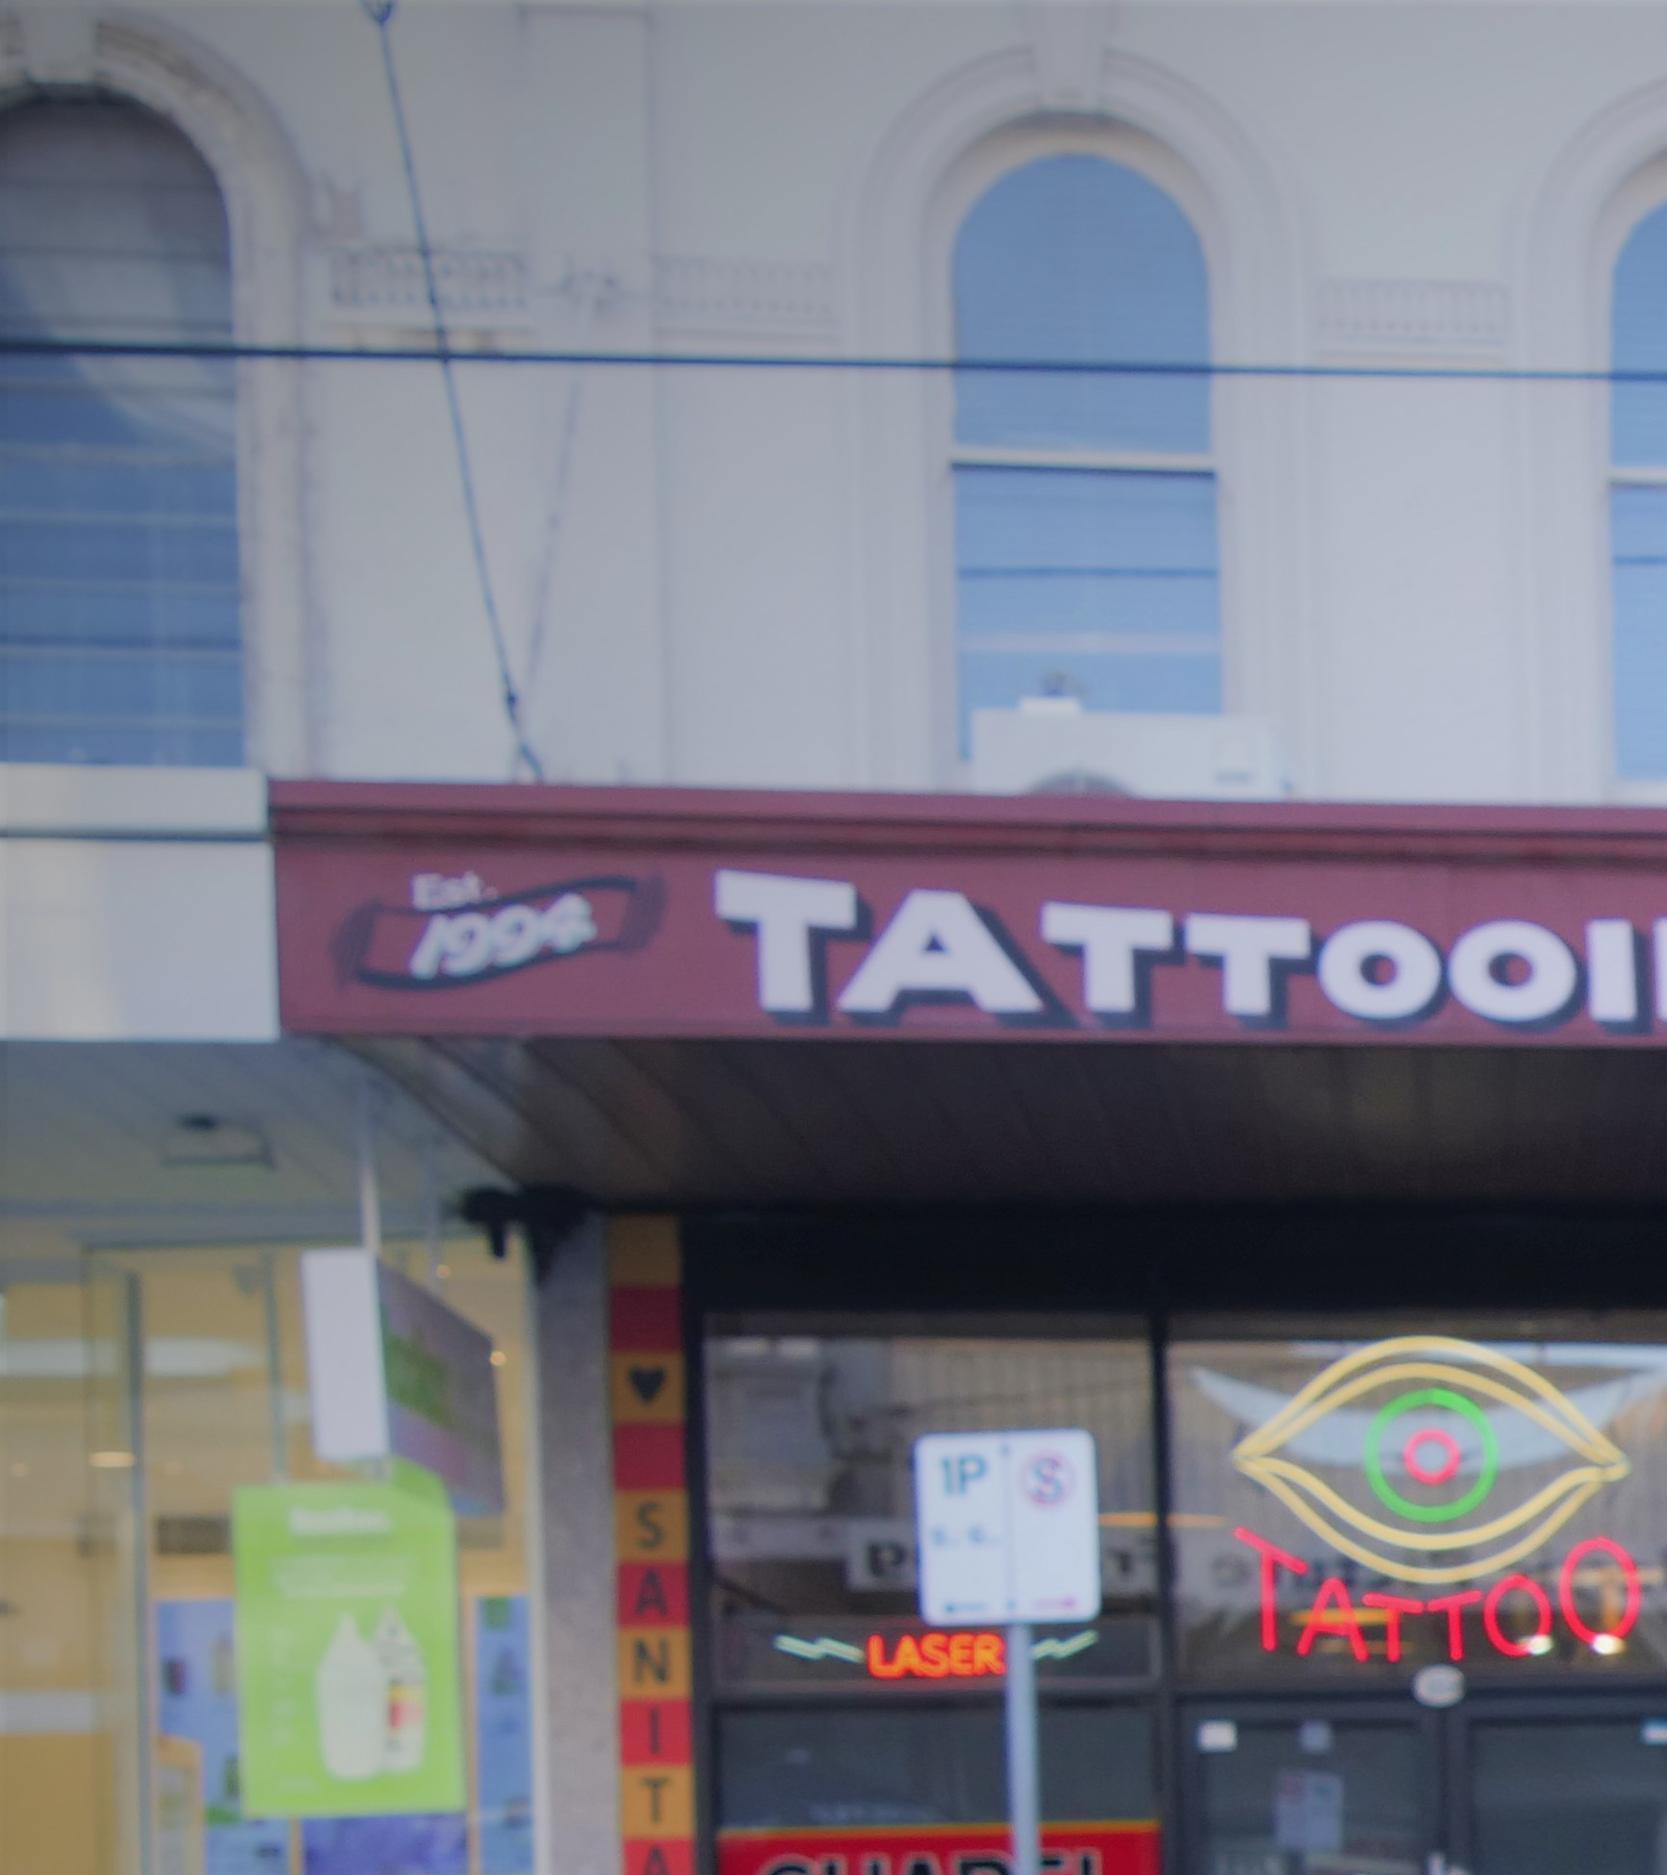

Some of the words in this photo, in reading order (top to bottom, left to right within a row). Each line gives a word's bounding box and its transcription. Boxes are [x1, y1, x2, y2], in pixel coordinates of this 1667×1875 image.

[409, 893, 597, 979] 1994
[940, 1453, 988, 1496] 1P
[1233, 1527, 1642, 1663] TATTOO
[866, 1632, 1006, 1679] LASER
